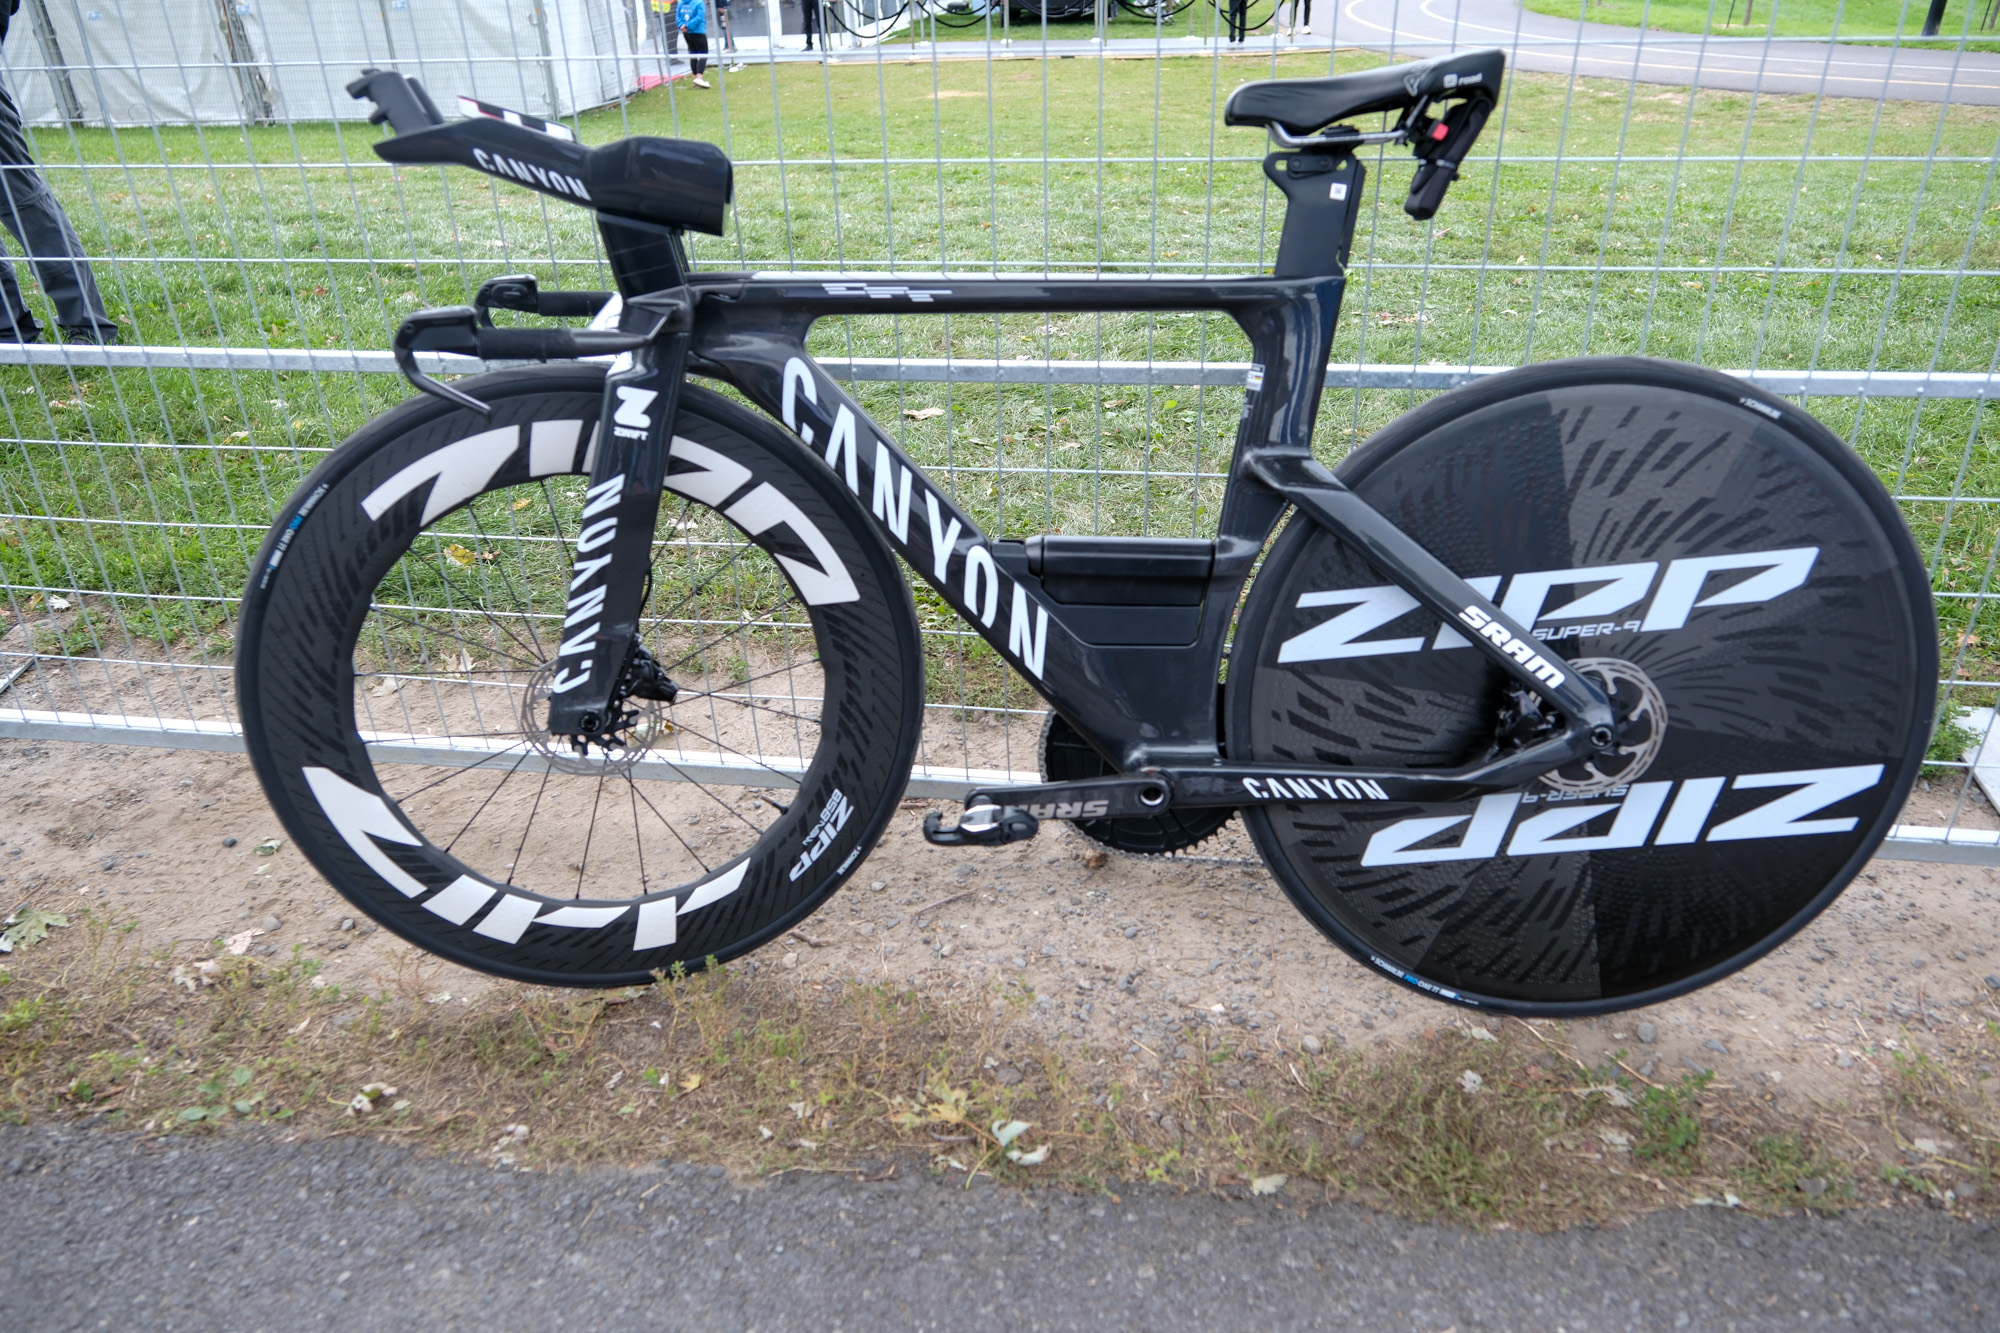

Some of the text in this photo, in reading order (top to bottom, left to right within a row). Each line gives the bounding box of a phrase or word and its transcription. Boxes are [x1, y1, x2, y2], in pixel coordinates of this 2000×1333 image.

[472, 147, 593, 202] CANYON
[613, 426, 649, 441] ZWIFT
[782, 356, 1049, 681] CANYON
[552, 473, 626, 694] CANYON
[1458, 605, 1566, 689] SRAM
[1531, 620, 1642, 640] SUPER-9
[1010, 800, 1109, 820] SRA
[1242, 777, 1390, 800] CANYON
[1361, 764, 1885, 867] ZIPP
[789, 796, 854, 882] ZIPP
